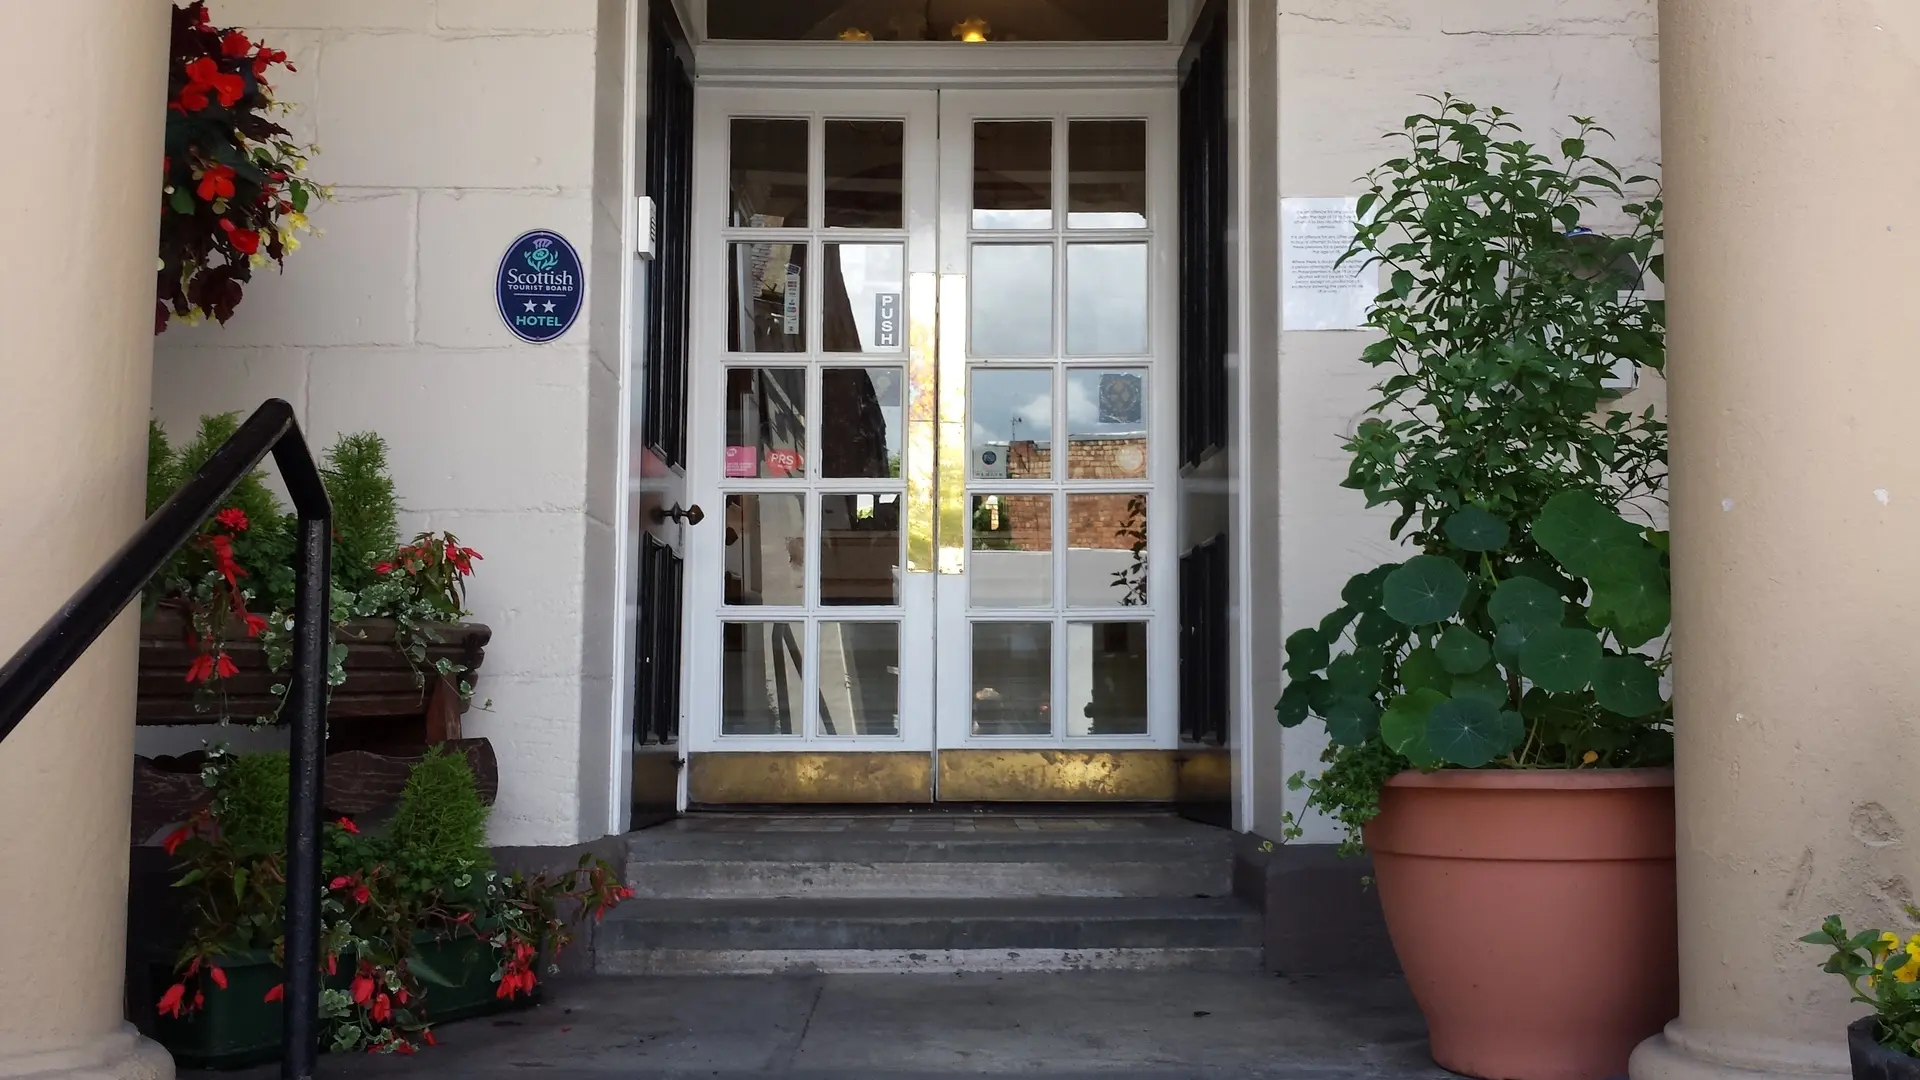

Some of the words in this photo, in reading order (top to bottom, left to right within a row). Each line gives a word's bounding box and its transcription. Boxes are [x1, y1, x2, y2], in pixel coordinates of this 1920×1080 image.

[507, 268, 574, 286] Scottish
[515, 315, 563, 327] HOTEL
[880, 295, 894, 345] PUSH
[770, 453, 795, 466] PRS
